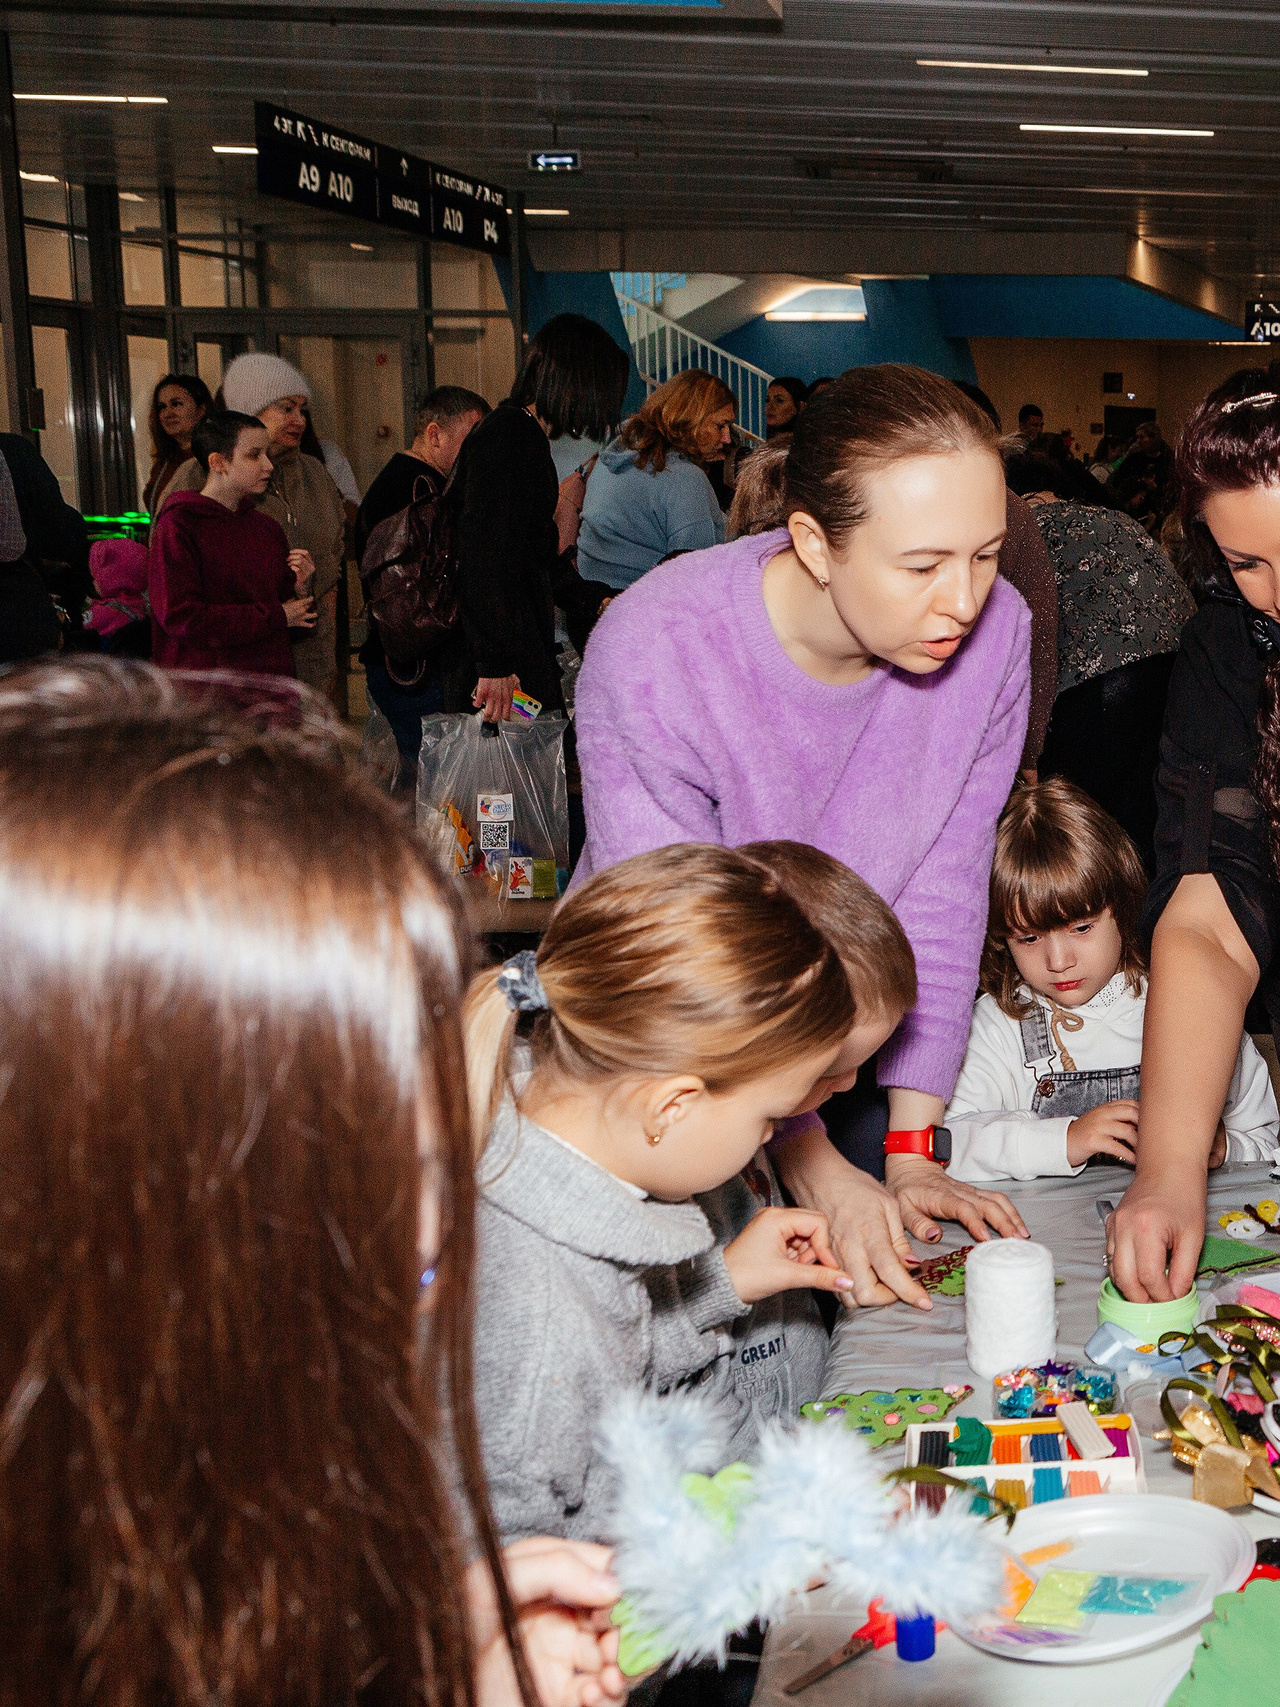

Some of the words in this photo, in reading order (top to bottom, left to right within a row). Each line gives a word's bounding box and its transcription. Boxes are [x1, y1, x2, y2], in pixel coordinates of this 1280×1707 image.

[298, 161, 320, 193] A9
[328, 170, 354, 203] A10
[392, 194, 420, 218] ВЫХОД
